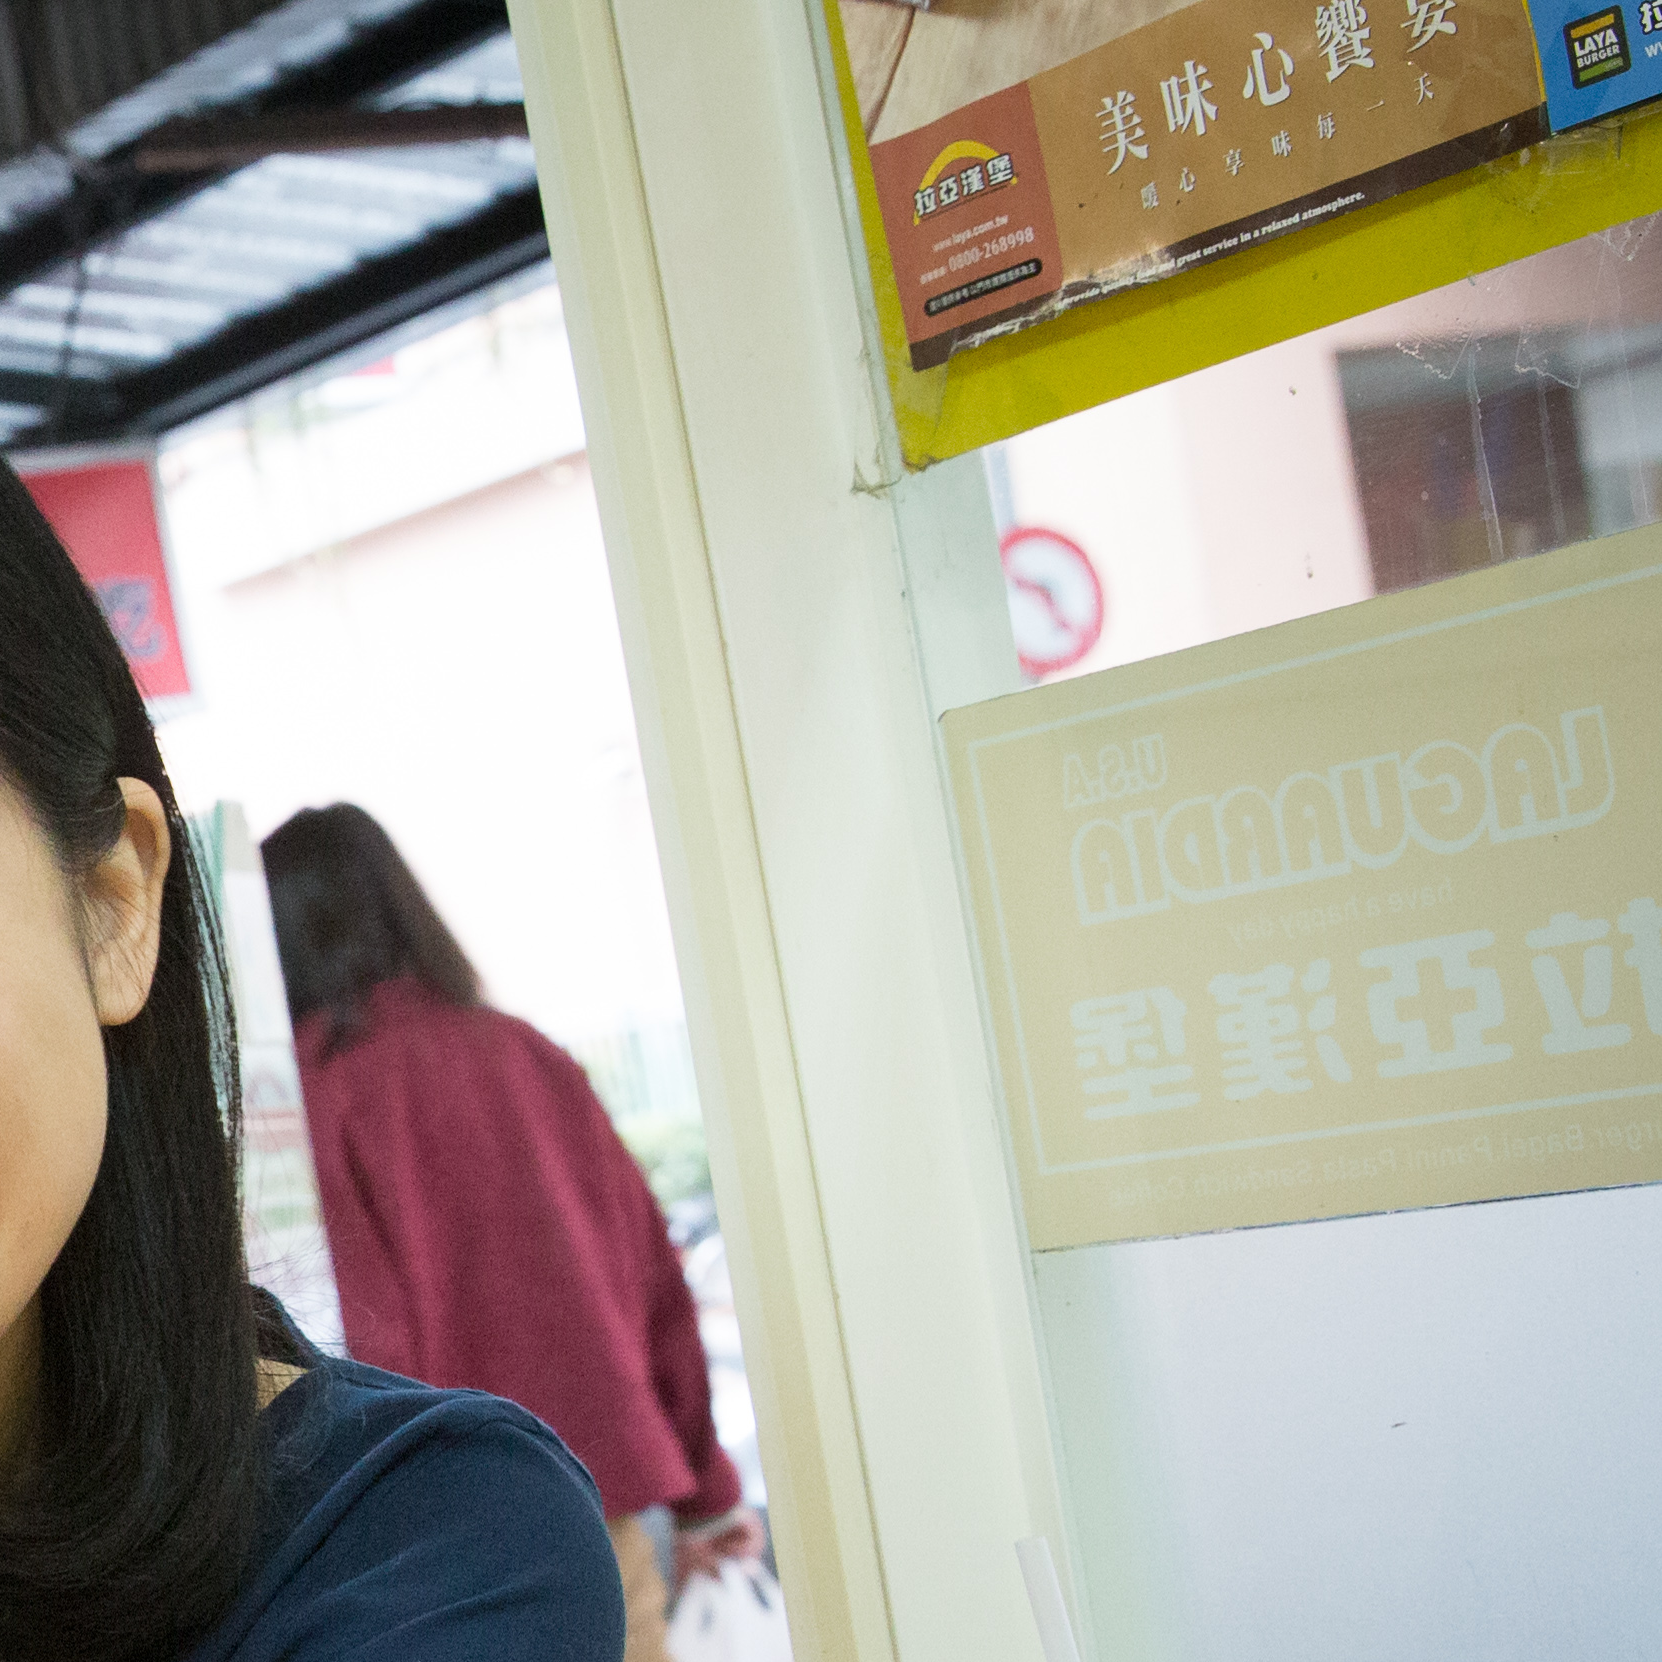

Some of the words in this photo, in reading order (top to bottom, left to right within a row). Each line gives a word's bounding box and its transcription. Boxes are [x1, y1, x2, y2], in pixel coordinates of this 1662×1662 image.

[1574, 28, 1618, 58] LAYA
[1577, 44, 1620, 69] BURGER
[914, 153, 1014, 217] 拉亞漢堡
[948, 226, 1036, 272] 0800-268998
[1176, 249, 1202, 268] great
[1203, 238, 1239, 256] service
[1240, 231, 1252, 243] in
[1261, 214, 1300, 235] relaxed
[1301, 190, 1366, 221] atmosphere.
